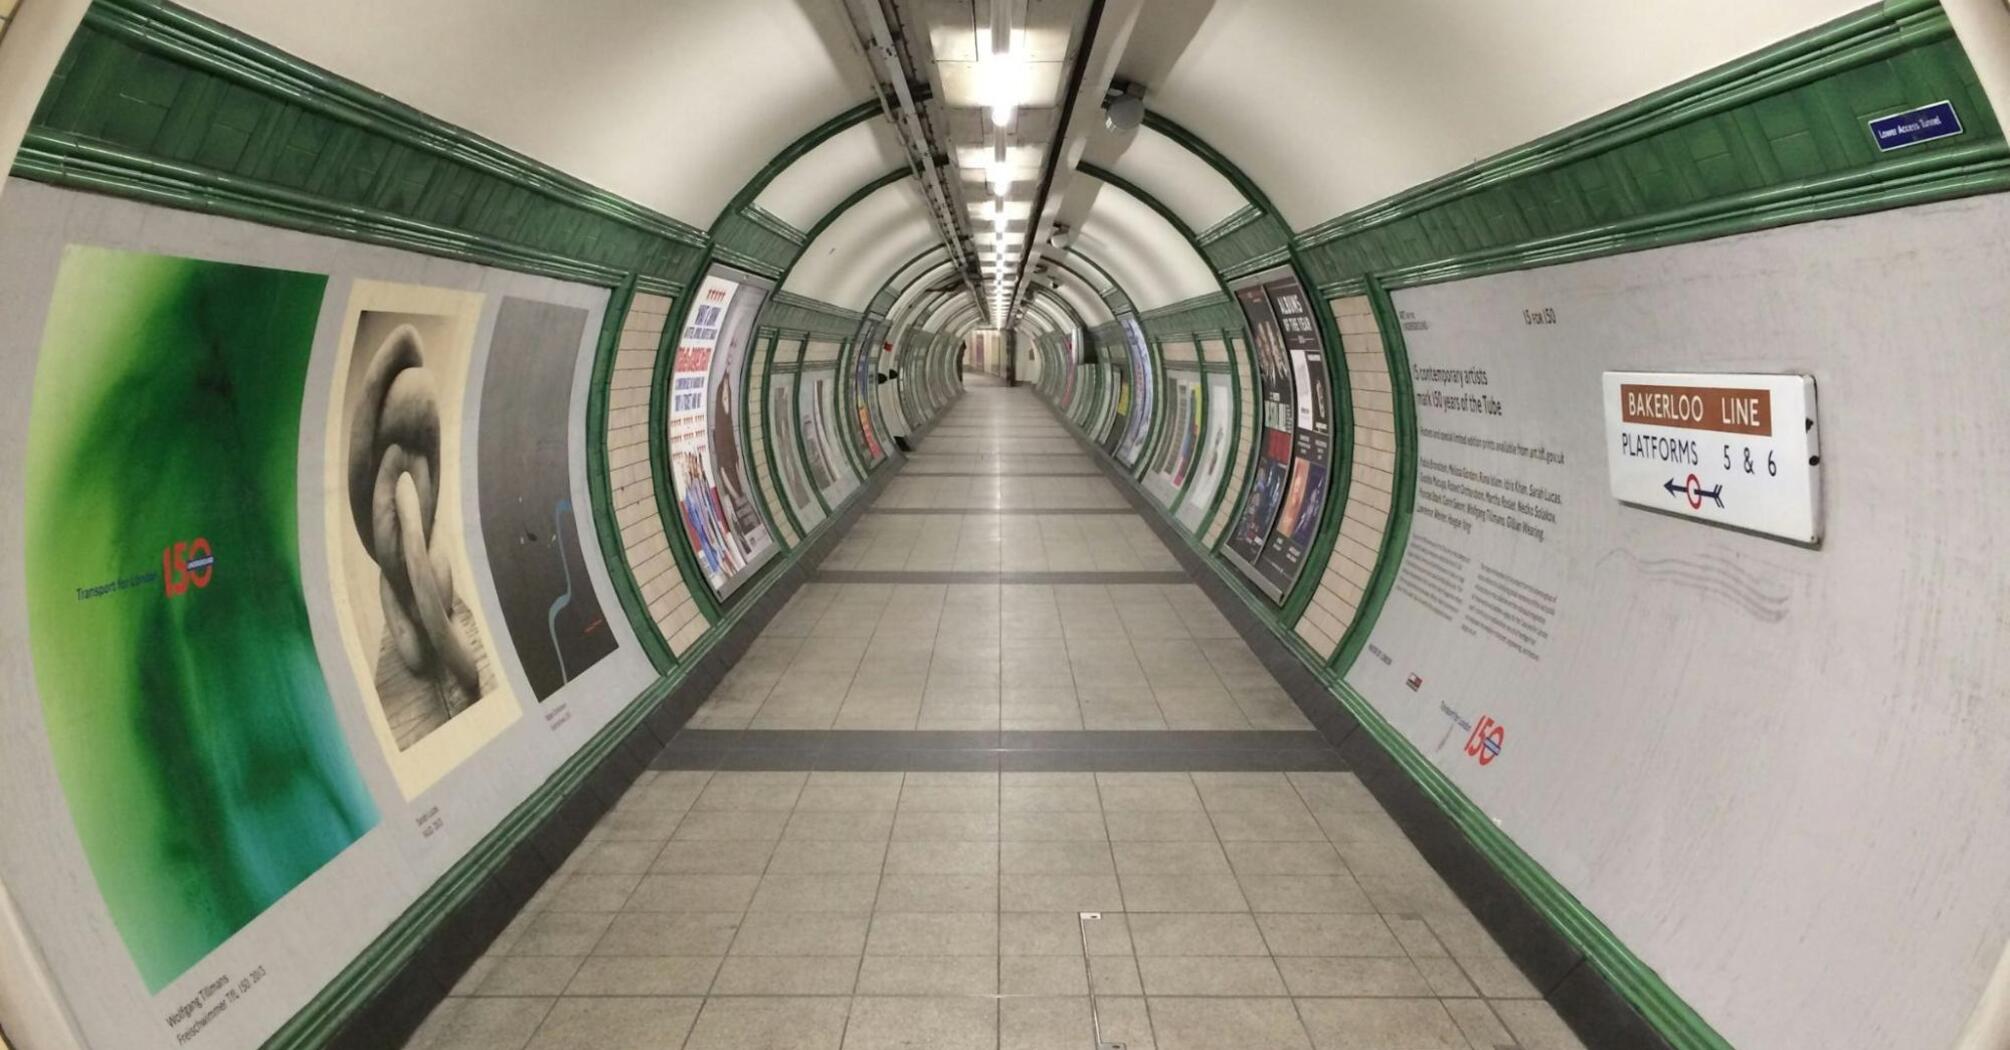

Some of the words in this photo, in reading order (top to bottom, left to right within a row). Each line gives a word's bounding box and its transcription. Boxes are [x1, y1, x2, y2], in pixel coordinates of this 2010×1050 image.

[1897, 123, 1920, 134] Access
[1522, 309, 1532, 325] 15
[1541, 307, 1557, 325] 150
[1419, 366, 1464, 388] contemporary
[1463, 366, 1488, 386] artists
[1431, 390, 1443, 409] 150
[1443, 393, 1461, 413] years
[1460, 393, 1470, 412] of
[1469, 394, 1482, 414] the
[1481, 395, 1502, 417] Tube
[1628, 391, 1704, 423] BAKERLOO
[1721, 397, 1760, 427] LINE
[1622, 432, 1699, 466] PLATFORMS
[1723, 444, 1731, 470] 5
[1743, 447, 1755, 475] &
[1768, 450, 1777, 477] 6
[163, 537, 214, 599] 150
[76, 581, 116, 601] Transport
[1464, 714, 1505, 766] 150
[166, 997, 203, 1028] Wolfgang
